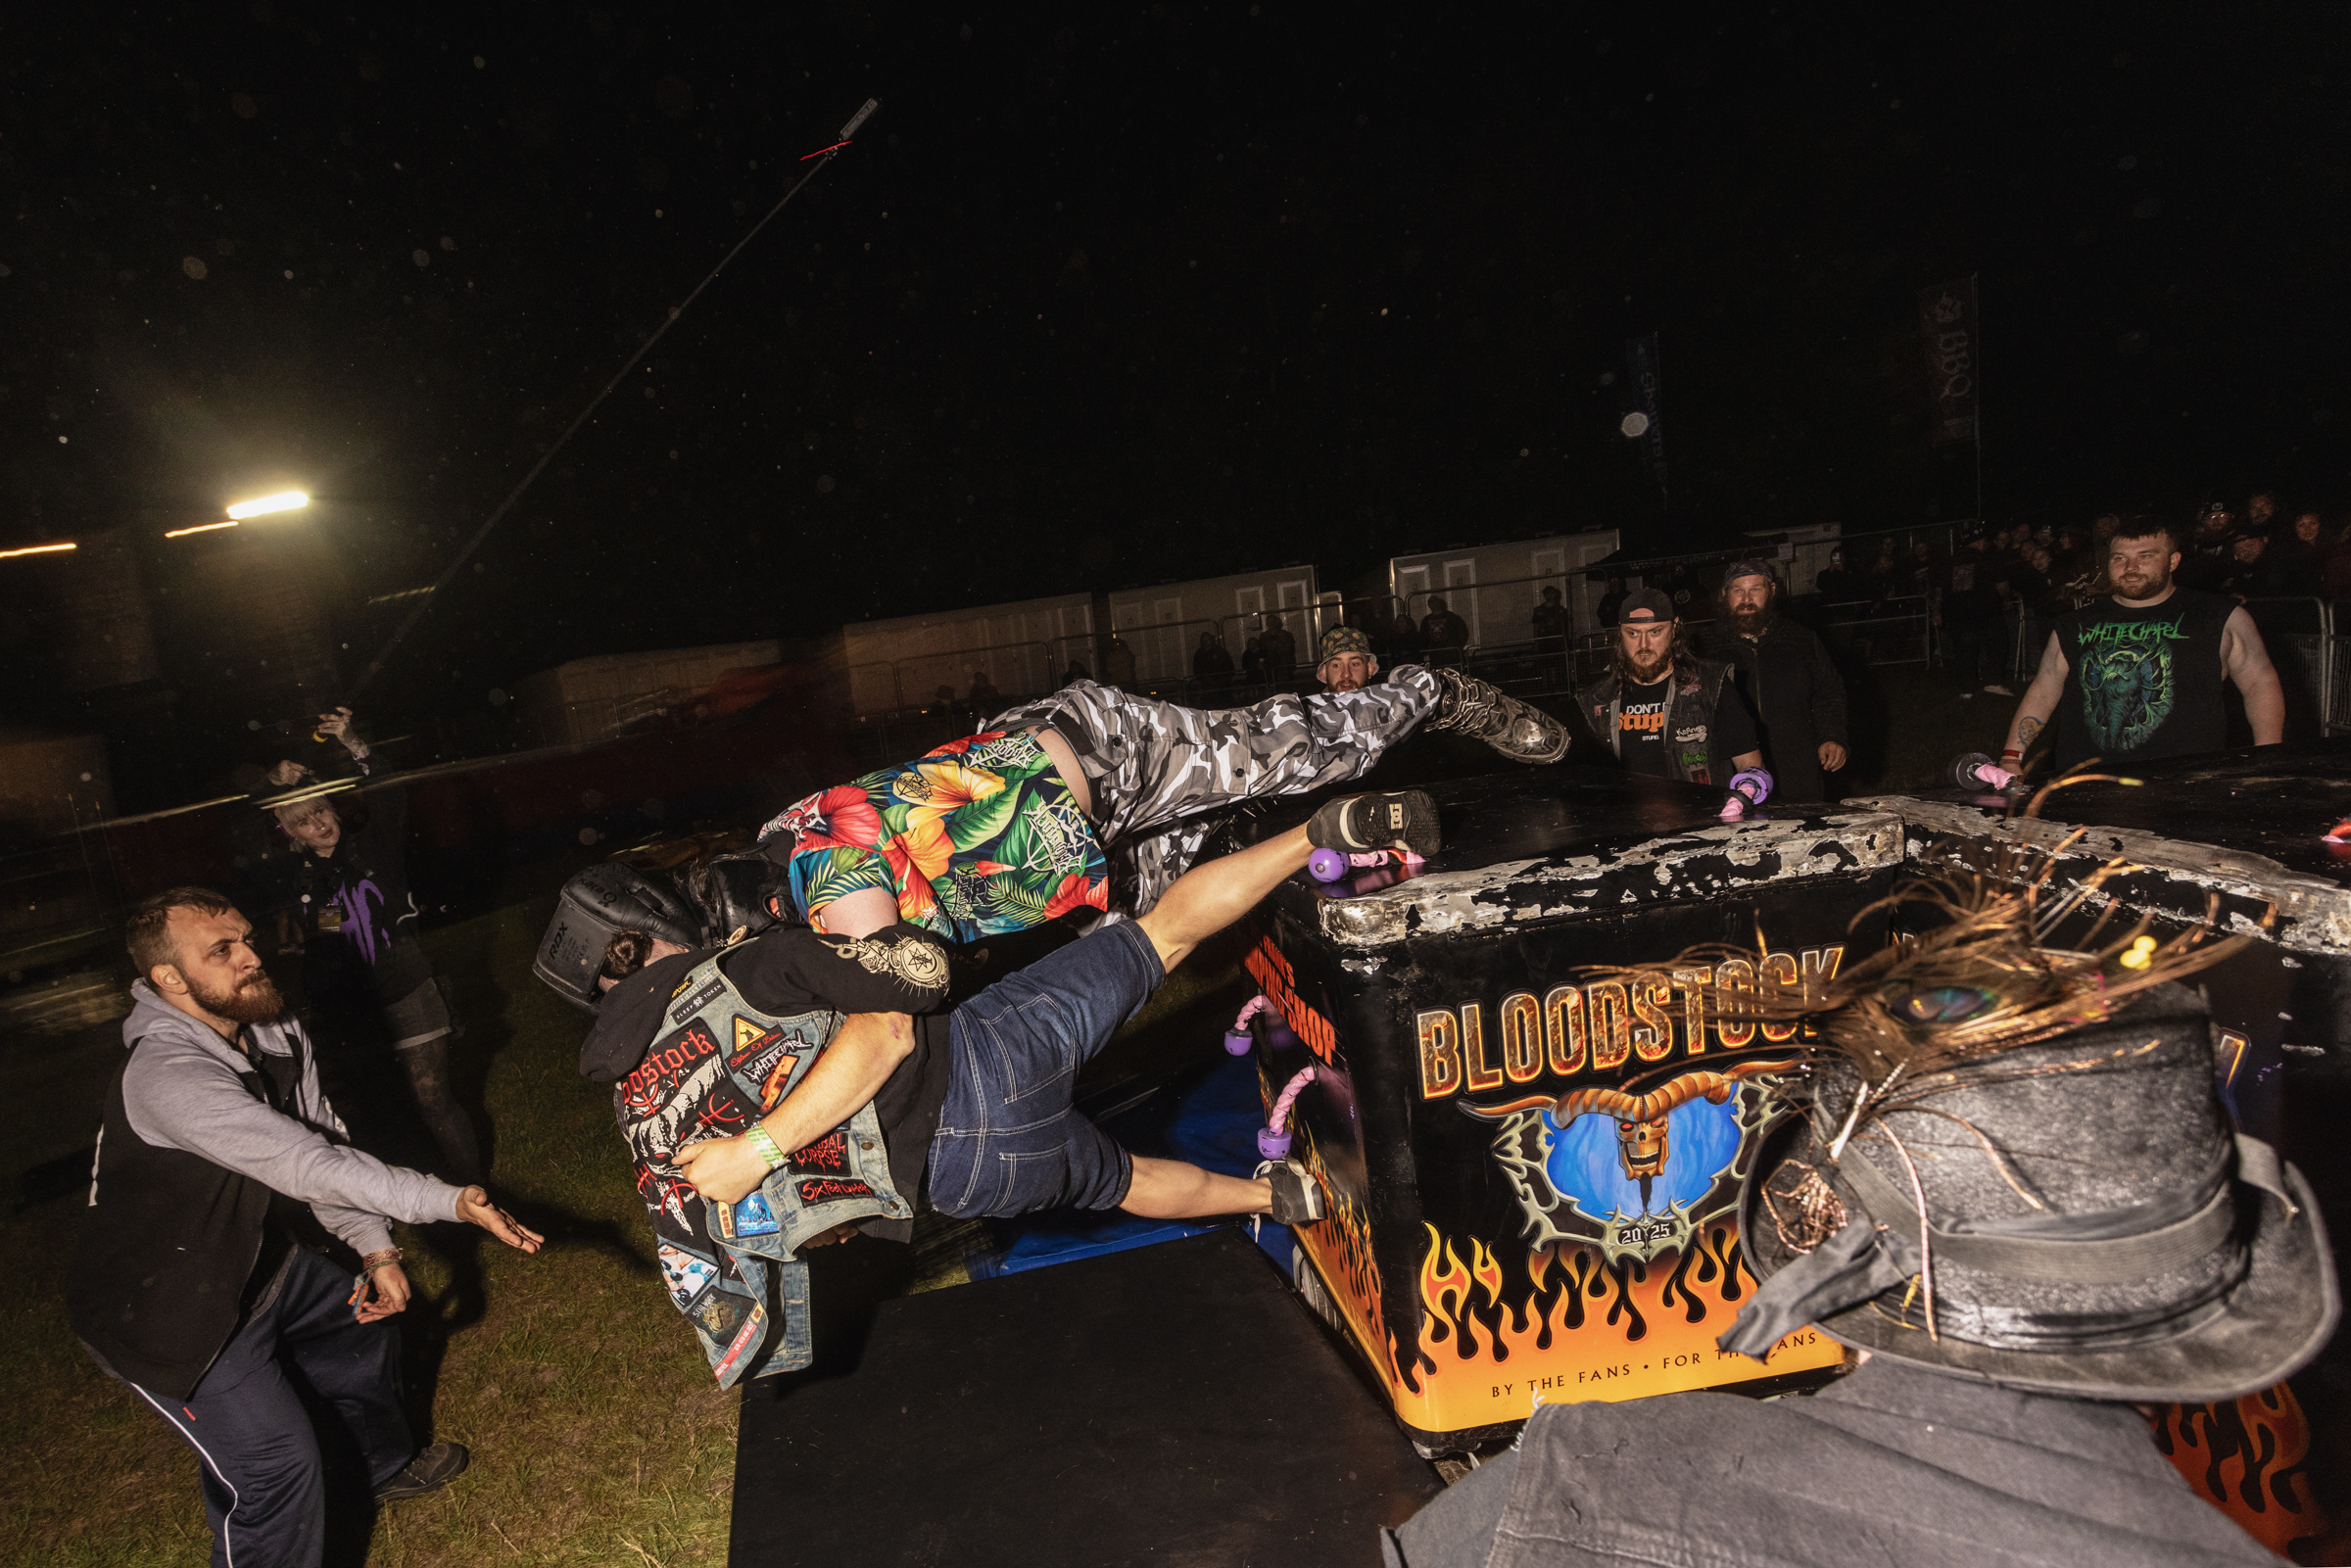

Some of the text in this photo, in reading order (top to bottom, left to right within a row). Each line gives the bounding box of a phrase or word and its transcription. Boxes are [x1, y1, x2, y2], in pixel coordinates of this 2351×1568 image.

[1626, 703, 1660, 715] DON'T
[549, 921, 569, 961] RDX
[676, 1005, 695, 1020] SLEEP
[703, 984, 723, 1000] TOKEN
[1285, 985, 1336, 1067] SHOP
[1416, 946, 1845, 1100] BLOODSTOCK
[794, 1149, 841, 1173] CORPSE
[1621, 1222, 1671, 1244] 20 25
[1492, 1384, 1513, 1398] BY
[1527, 1375, 1565, 1392] THE
[1578, 1363, 1631, 1383] FANS
[1663, 1353, 1702, 1369] FOR
[1775, 1332, 1817, 1352] ANS
